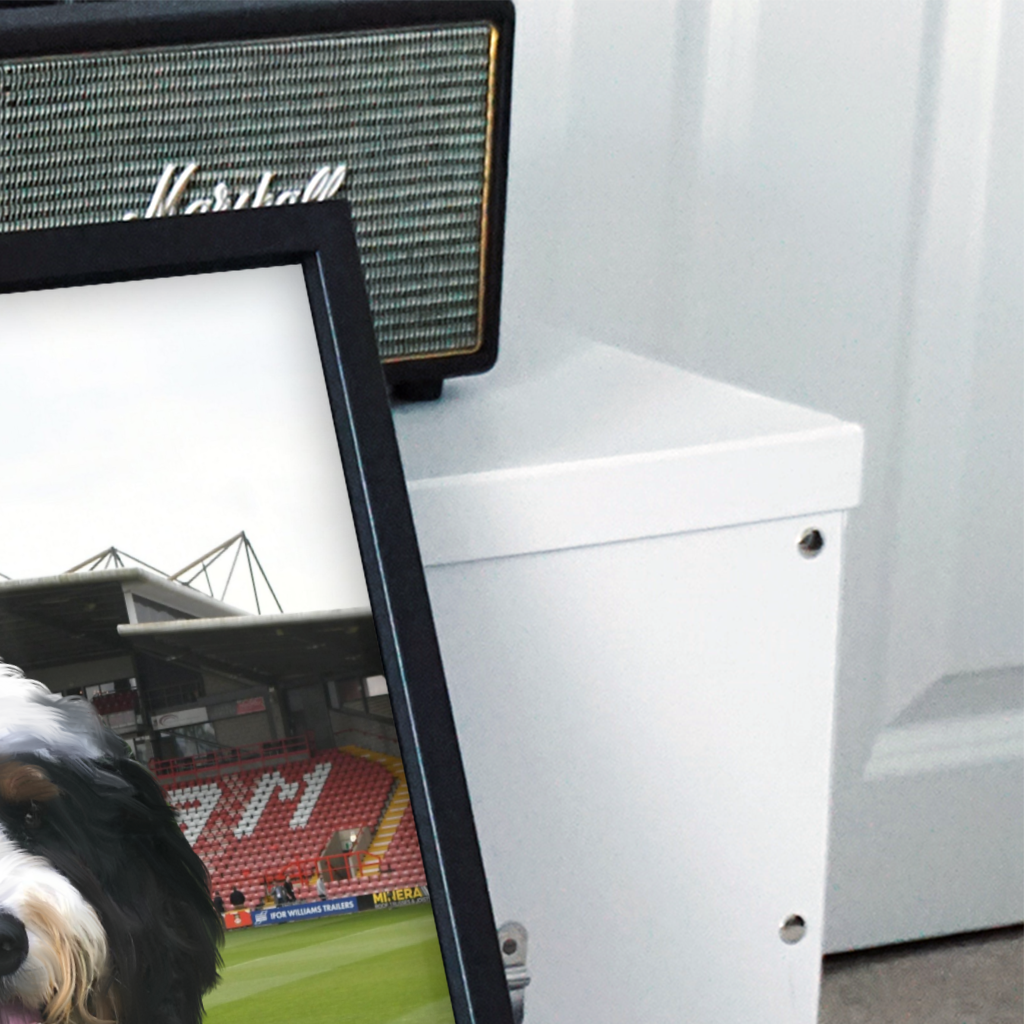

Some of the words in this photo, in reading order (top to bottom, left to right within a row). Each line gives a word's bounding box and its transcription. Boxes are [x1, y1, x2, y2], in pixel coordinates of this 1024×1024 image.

[270, 911, 286, 920] IFOR
[287, 905, 321, 918] WILLIAMS
[323, 900, 354, 913] TRAILERS
